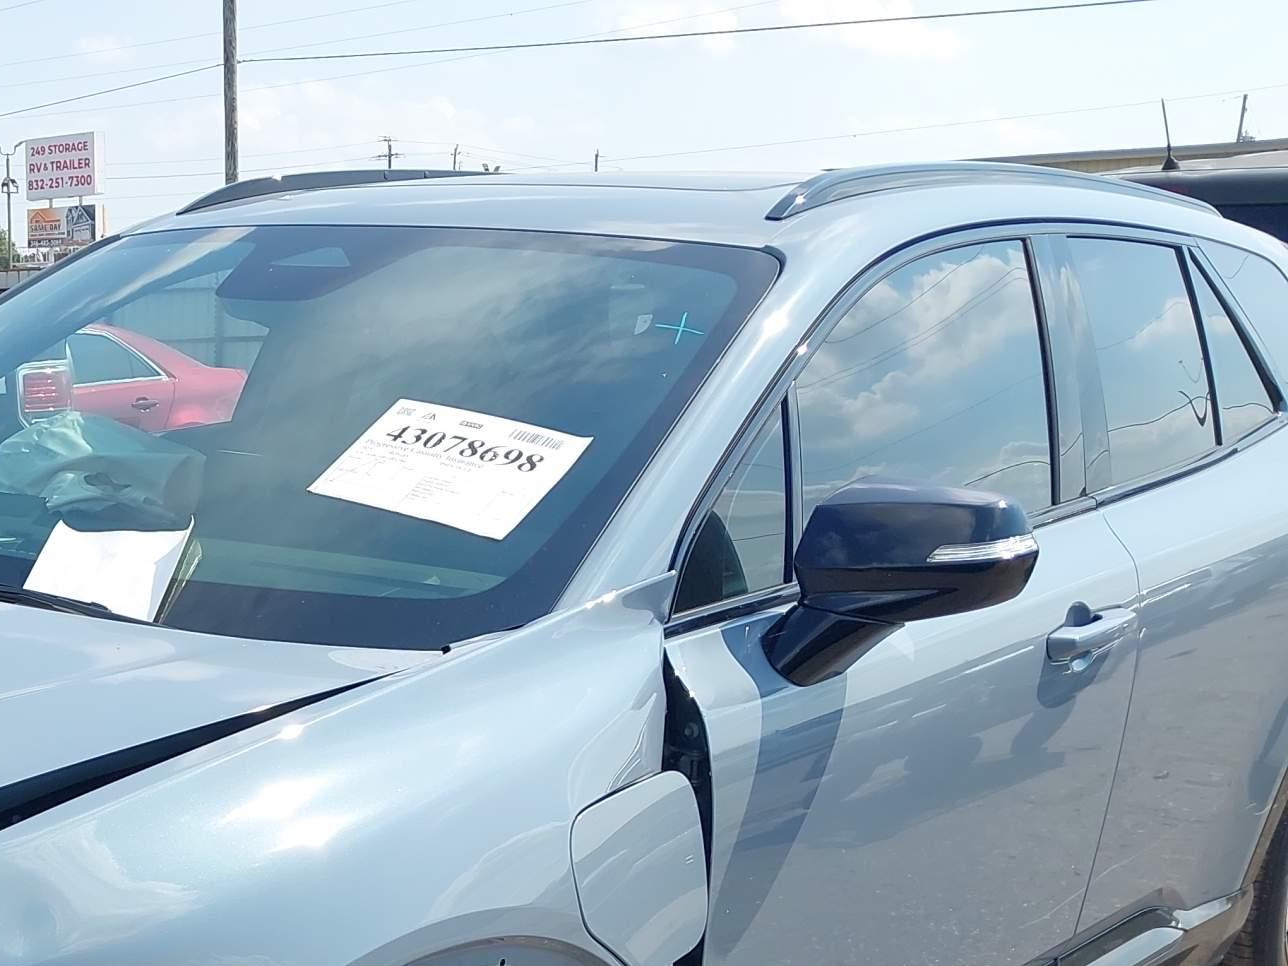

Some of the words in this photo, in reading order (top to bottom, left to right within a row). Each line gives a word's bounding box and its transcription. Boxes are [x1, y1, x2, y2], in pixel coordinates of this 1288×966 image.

[30, 146, 46, 157] 249
[47, 141, 89, 155] STORAGE
[29, 162, 42, 175] RV
[43, 163, 48, 171] &
[50, 158, 91, 172] TRAILER
[28, 174, 92, 191] 832-251-7300
[386, 425, 544, 473] 43078698
